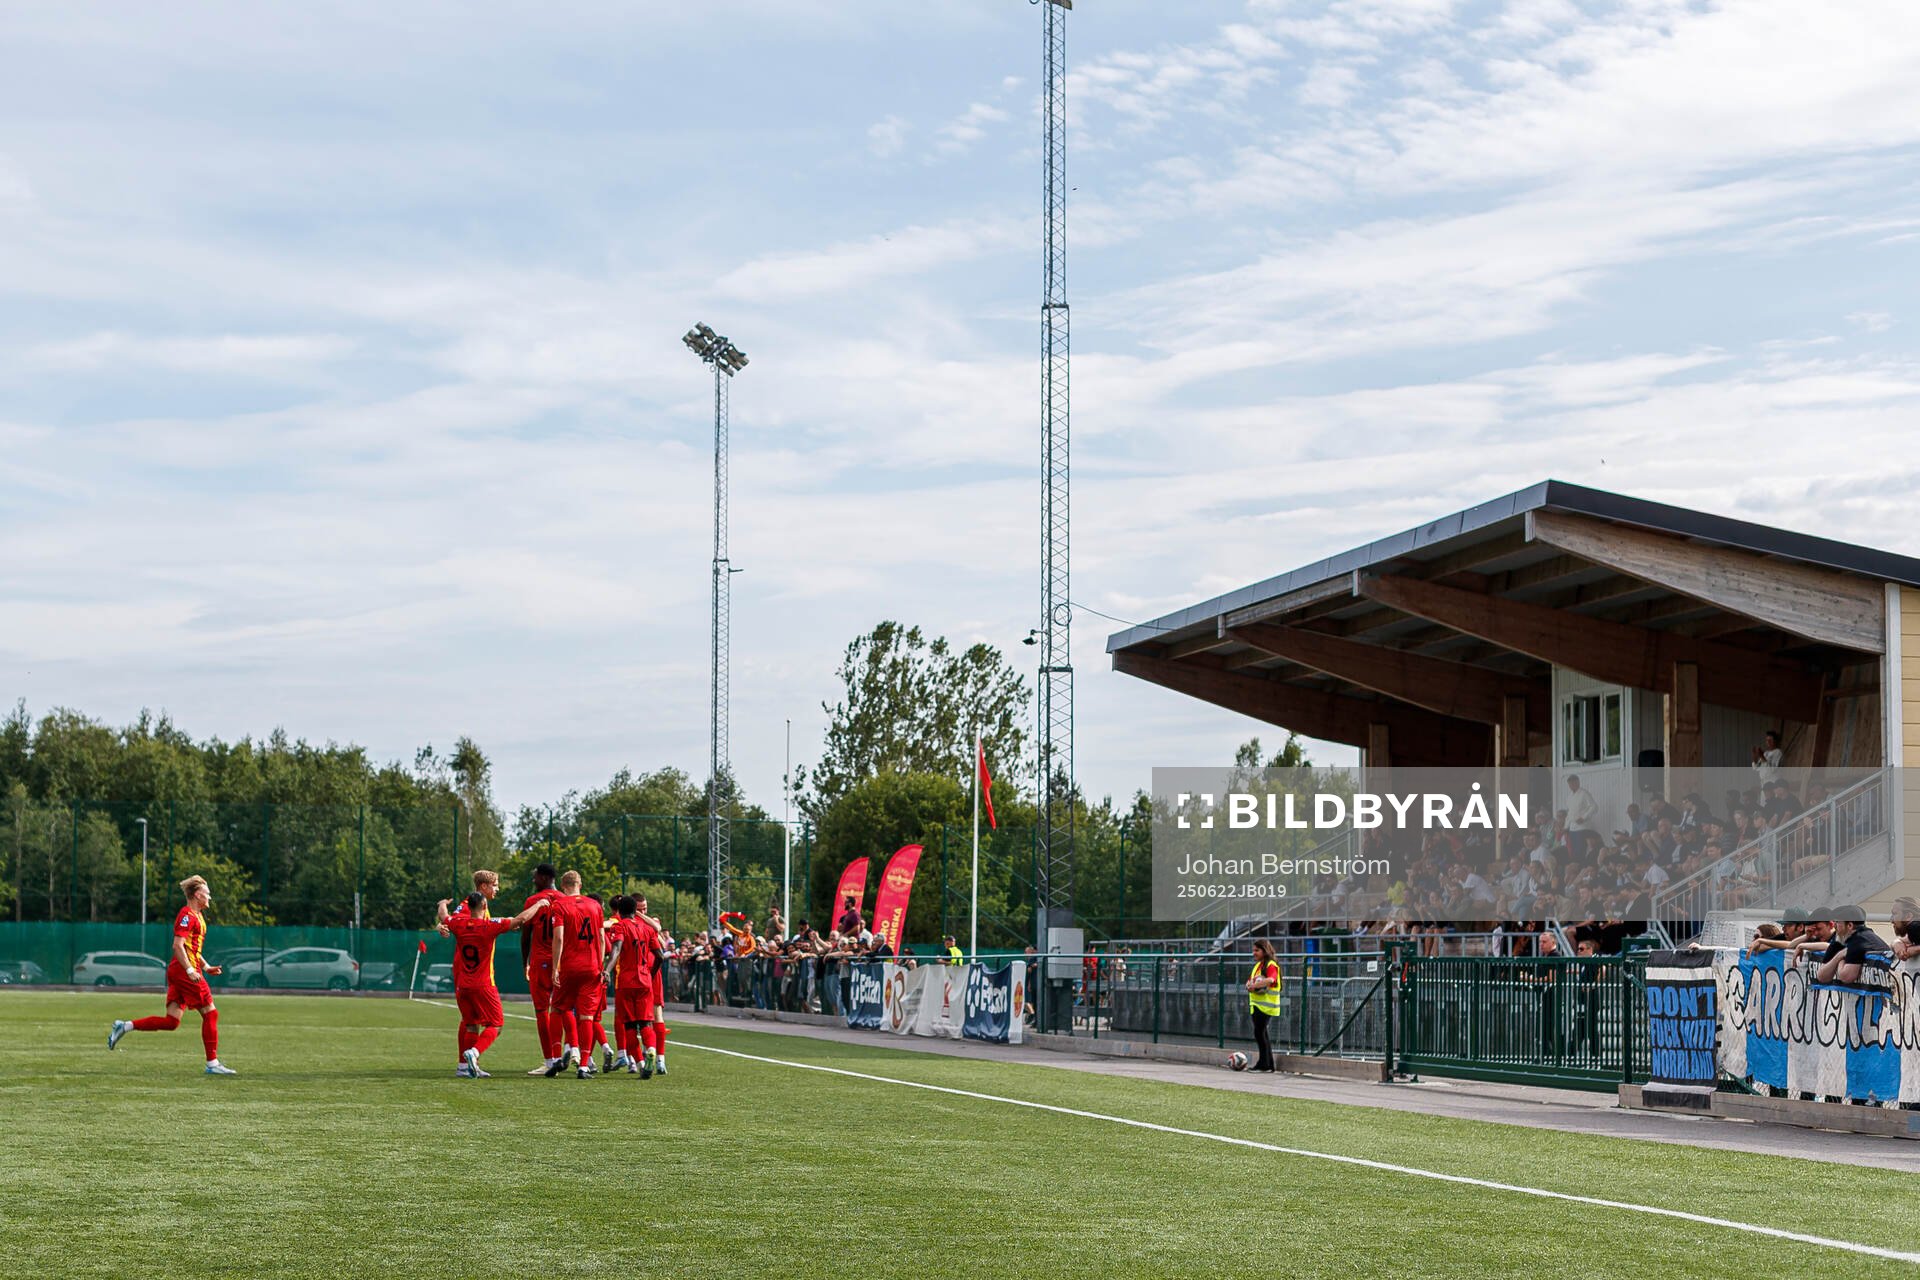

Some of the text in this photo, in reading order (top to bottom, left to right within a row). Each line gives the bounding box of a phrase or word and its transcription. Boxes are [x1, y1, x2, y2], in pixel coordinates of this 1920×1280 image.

[578, 916, 595, 945] 4
[462, 944, 480, 970] 9
[1646, 985, 1717, 1018] DON'T
[1650, 1018, 1716, 1050] FUCK WITH
[1652, 1047, 1715, 1080] NORRLAND
